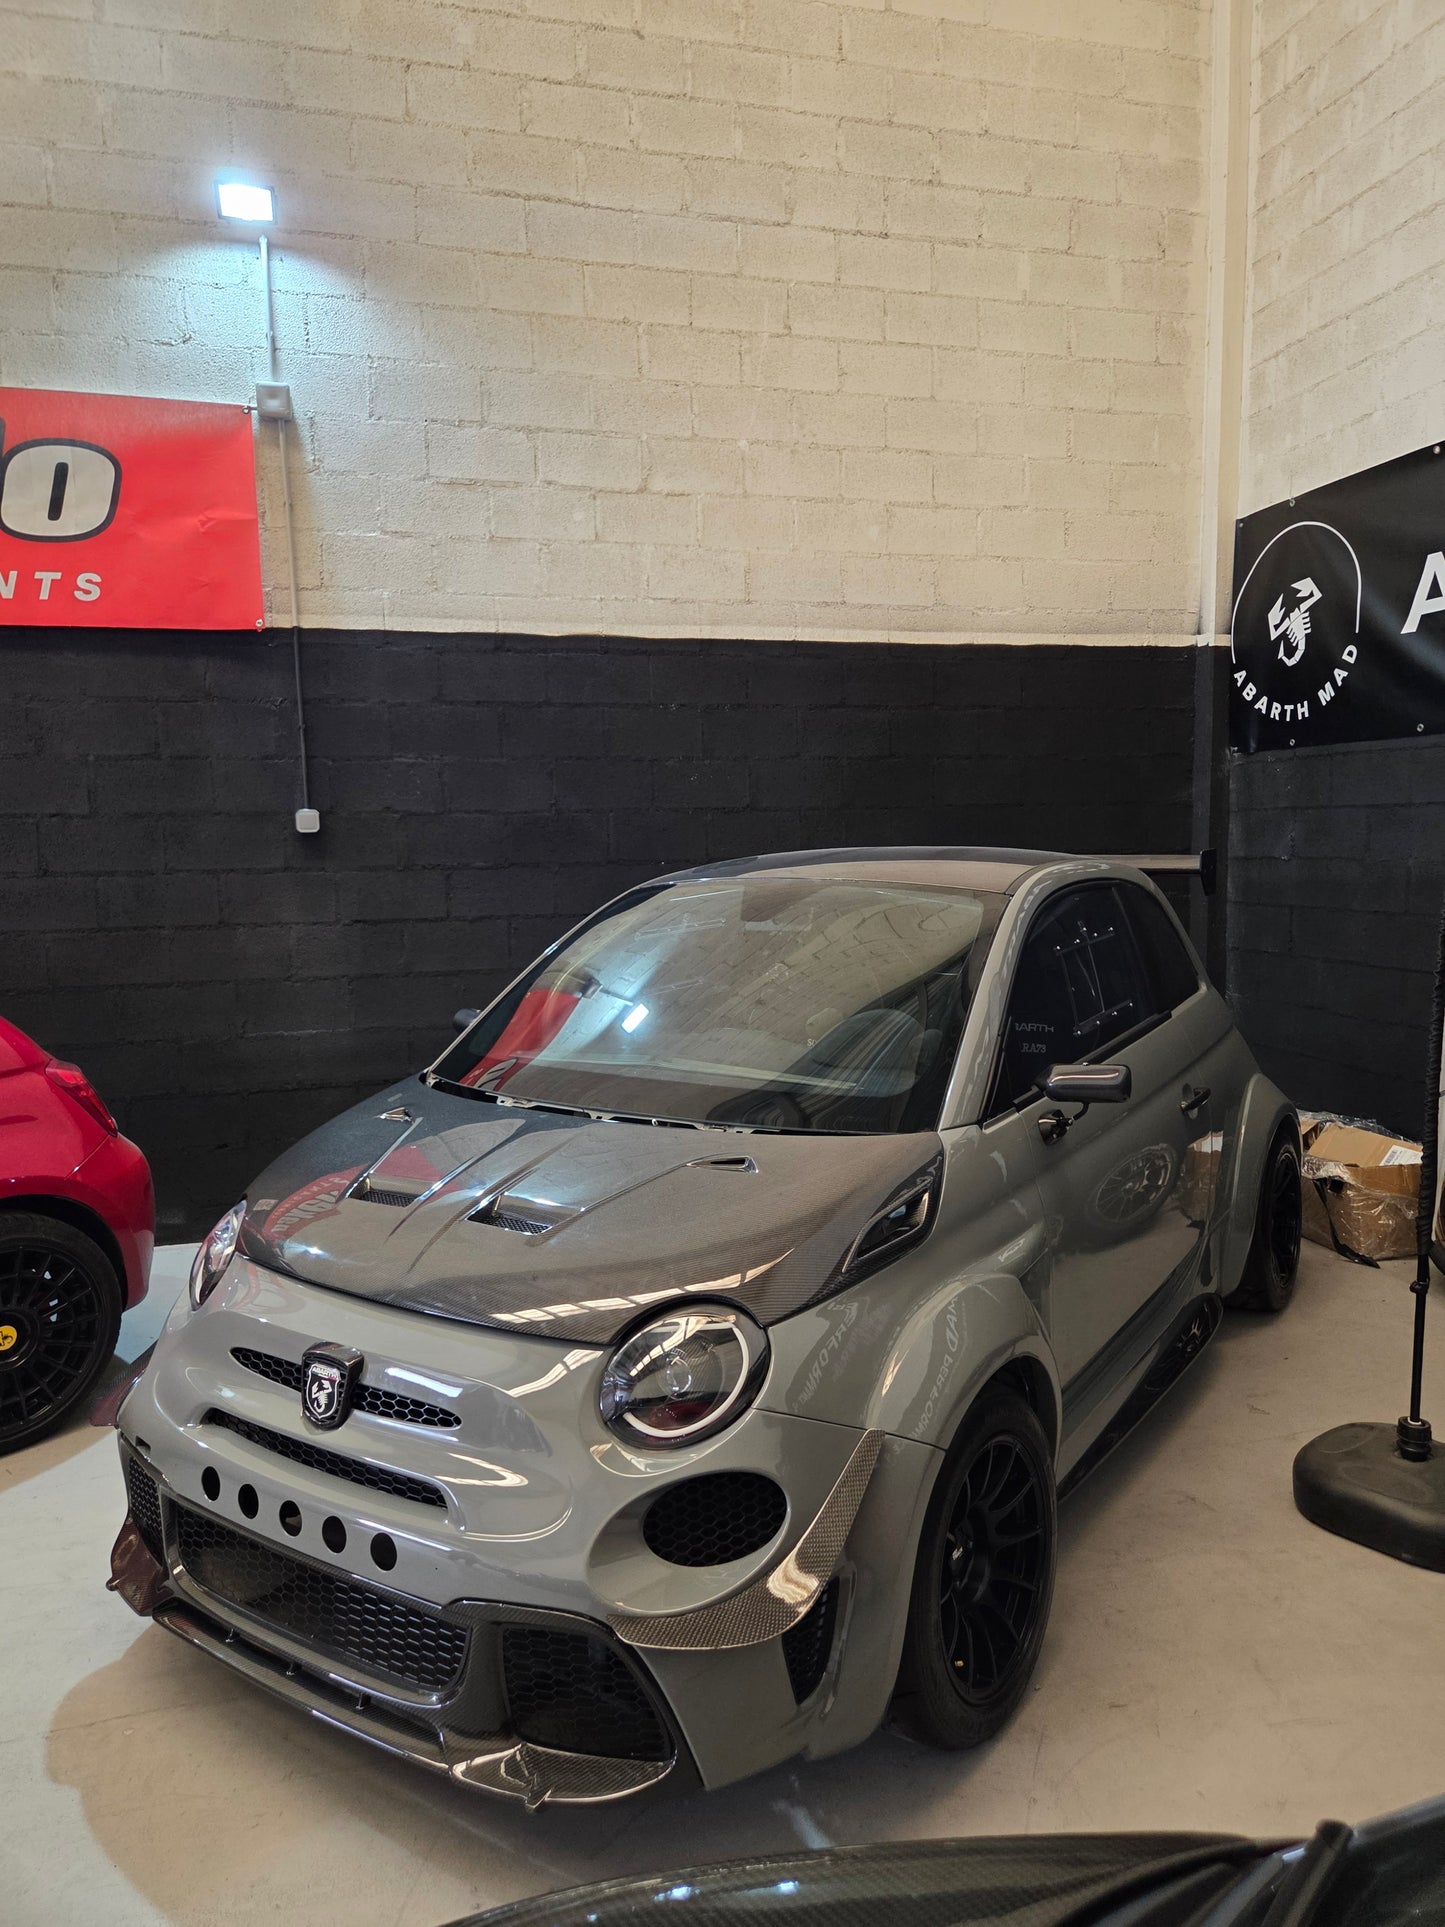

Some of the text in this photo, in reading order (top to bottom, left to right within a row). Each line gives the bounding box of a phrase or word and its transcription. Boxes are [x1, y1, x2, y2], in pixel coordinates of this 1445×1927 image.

[0, 417, 122, 543] o
[1234, 644, 1358, 721] ABARTH MAD
